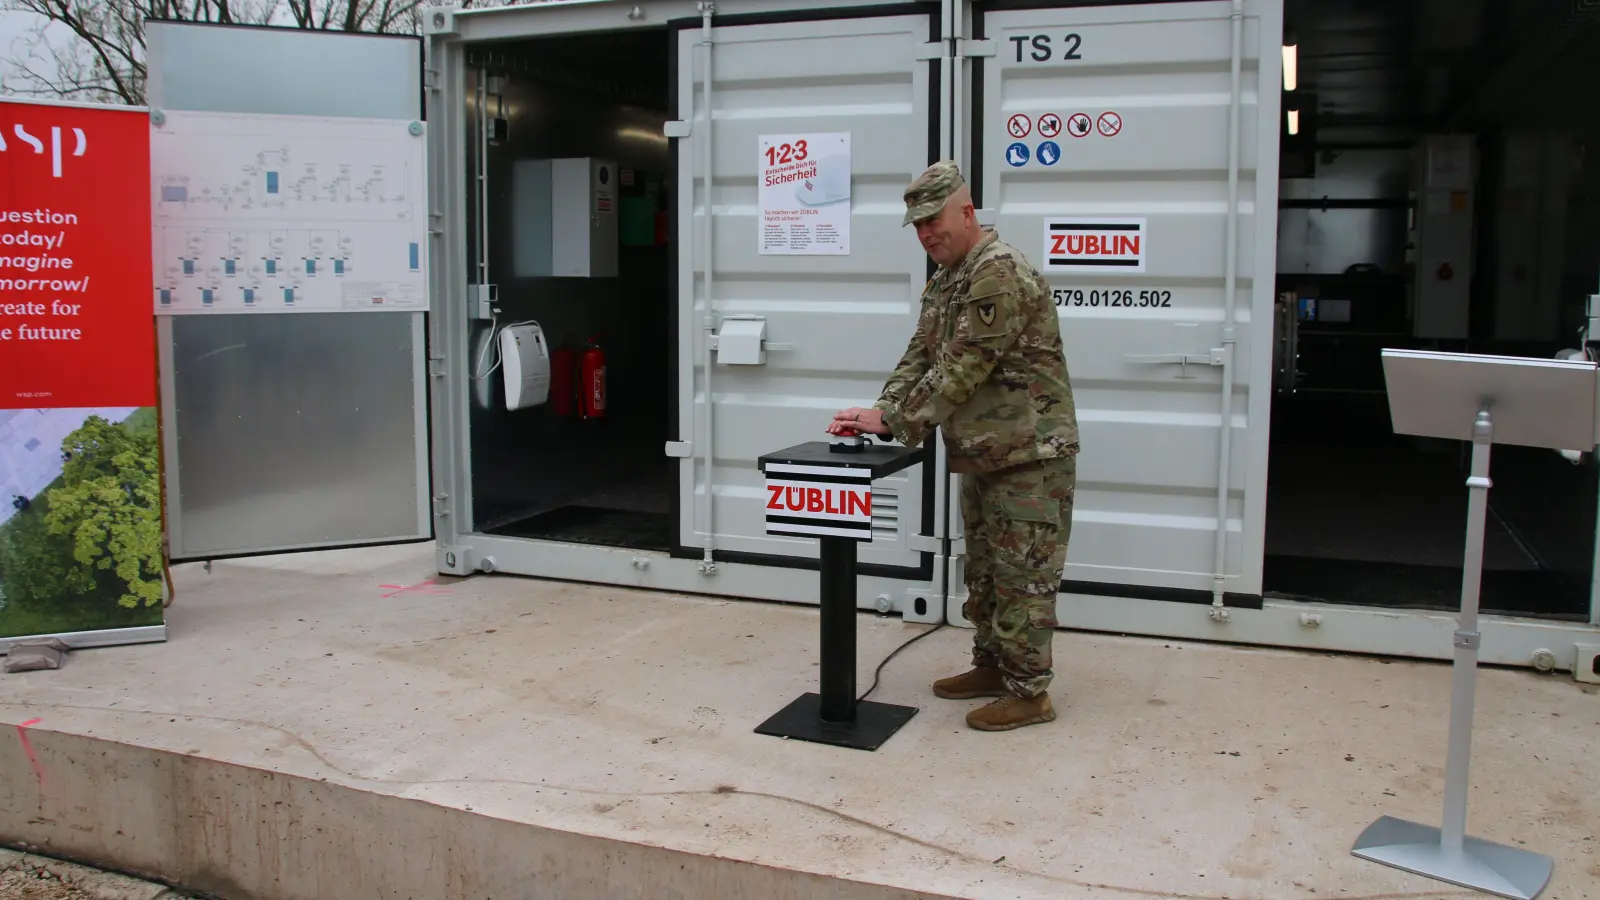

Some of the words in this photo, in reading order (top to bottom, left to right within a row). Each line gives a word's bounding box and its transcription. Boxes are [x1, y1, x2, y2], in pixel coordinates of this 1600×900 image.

[1009, 34, 1052, 62] TS
[1063, 33, 1082, 60] 2
[765, 164, 796, 176] Entscheide
[795, 161, 808, 169] Dich
[765, 167, 817, 187] Sicherheit
[1050, 234, 1140, 255] ZÜBLIN
[51, 299, 81, 316] for
[18, 323, 82, 340] future
[766, 484, 872, 516] ZÜBLIN
